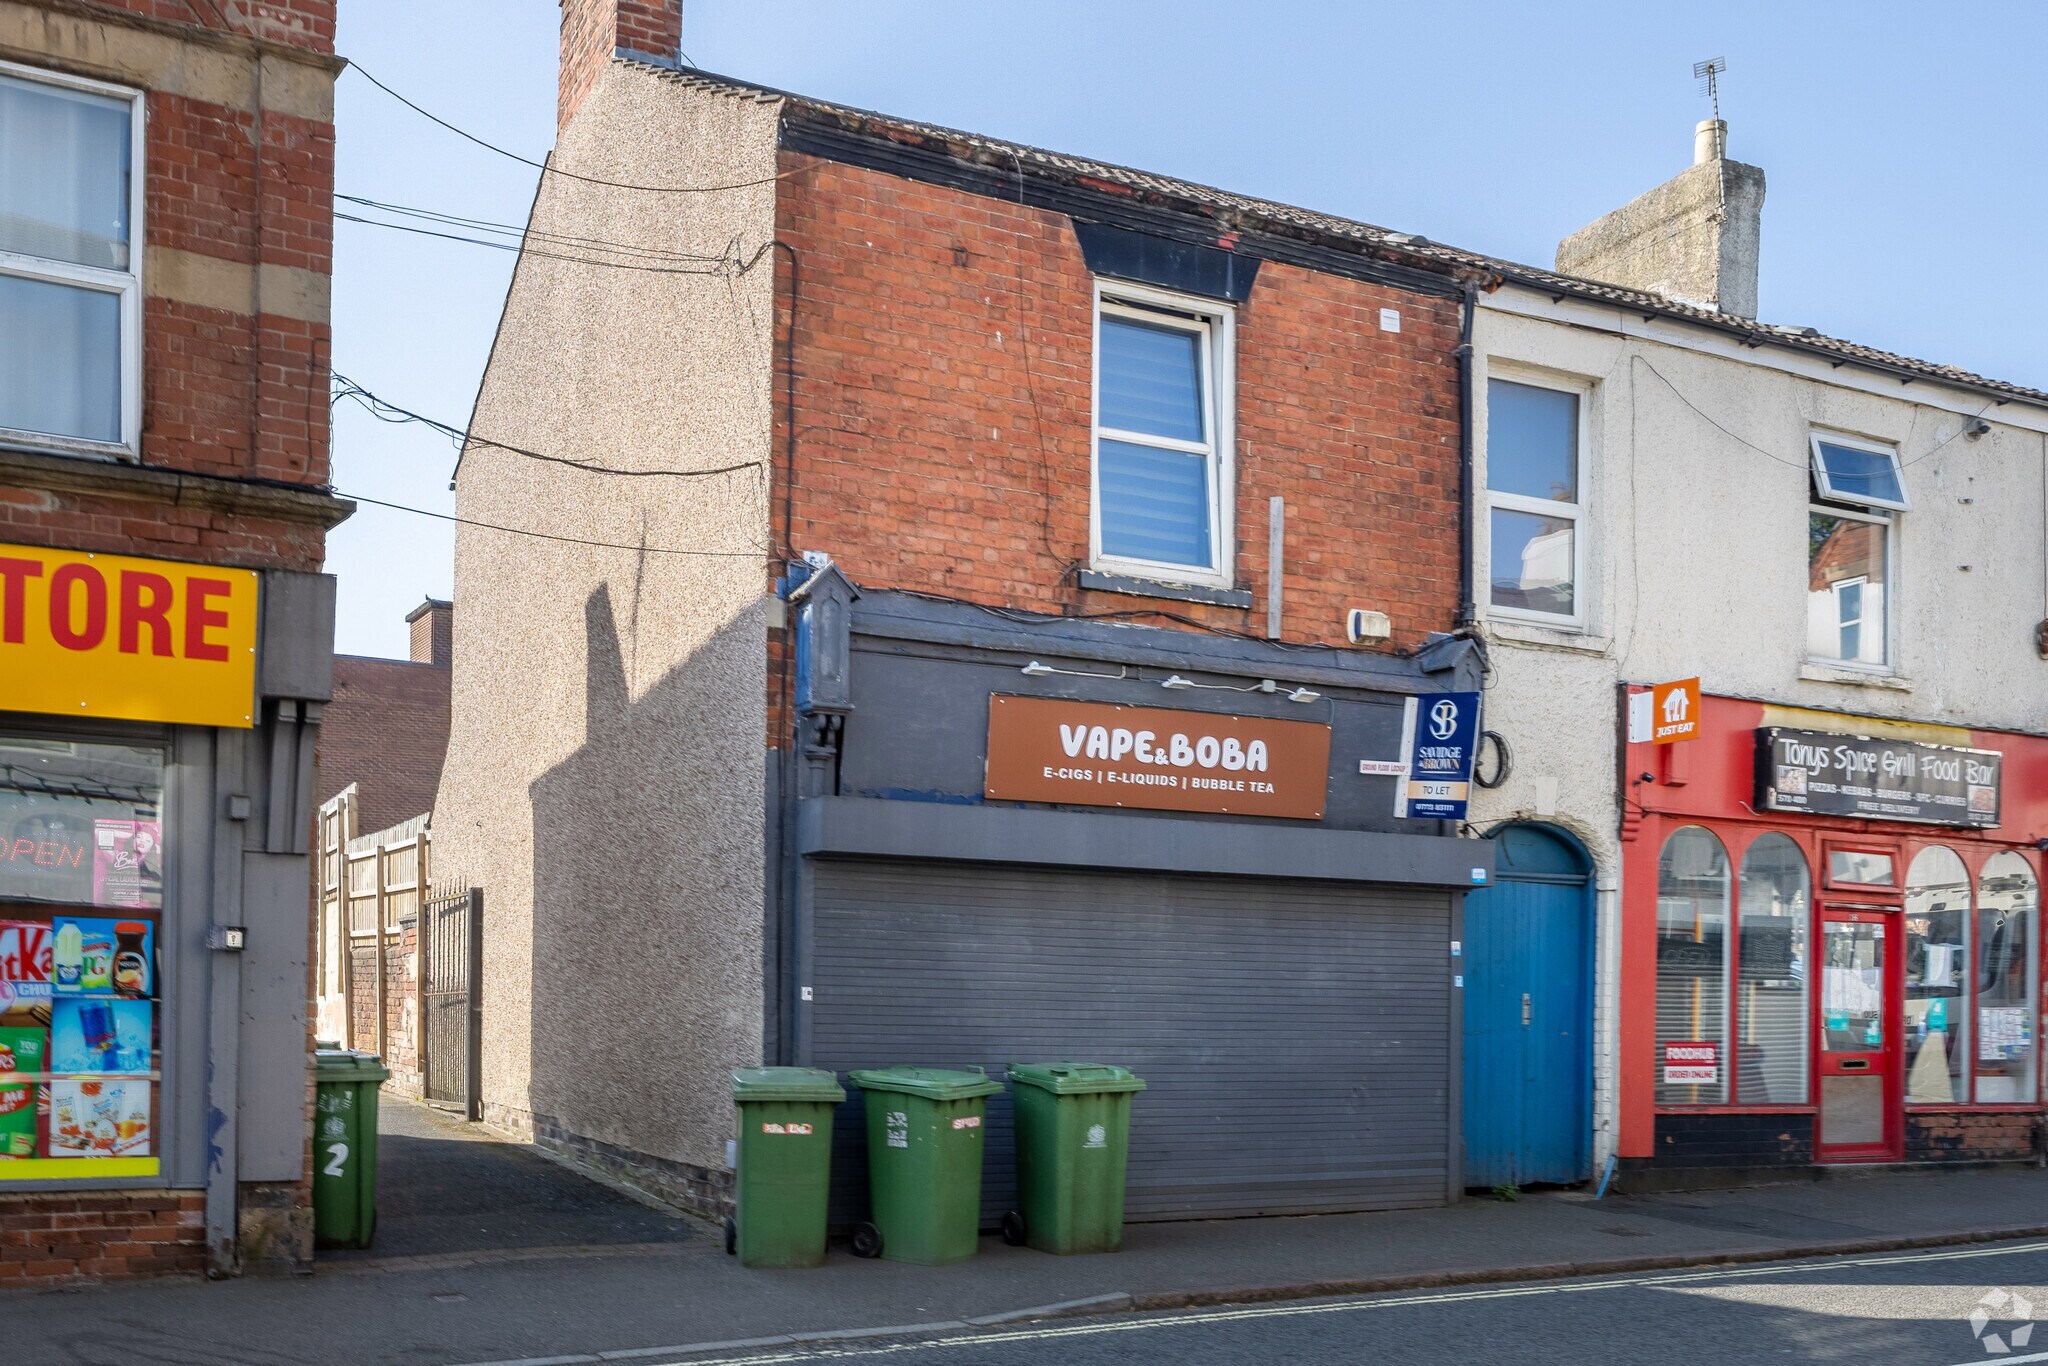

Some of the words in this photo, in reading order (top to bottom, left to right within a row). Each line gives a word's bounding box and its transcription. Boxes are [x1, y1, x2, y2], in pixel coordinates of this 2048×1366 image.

[1656, 724, 1677, 738] JUST
[1677, 722, 1695, 733] EAT
[1779, 738, 1830, 776] Tonys
[1834, 745, 1877, 781] Spice
[1882, 750, 1916, 779] Grill
[1921, 755, 1960, 782] Food
[1964, 759, 1994, 785] Bar
[1043, 766, 1093, 781] E-CIGS
[1107, 771, 1178, 787] E-LIQUIDS
[1191, 777, 1245, 792] BUBBLE
[1249, 781, 1275, 794] TEA
[1422, 785, 1434, 795] TO
[1435, 786, 1451, 796] LET
[1666, 1047, 1716, 1060] FOODHUB
[323, 1142, 350, 1178] 2
